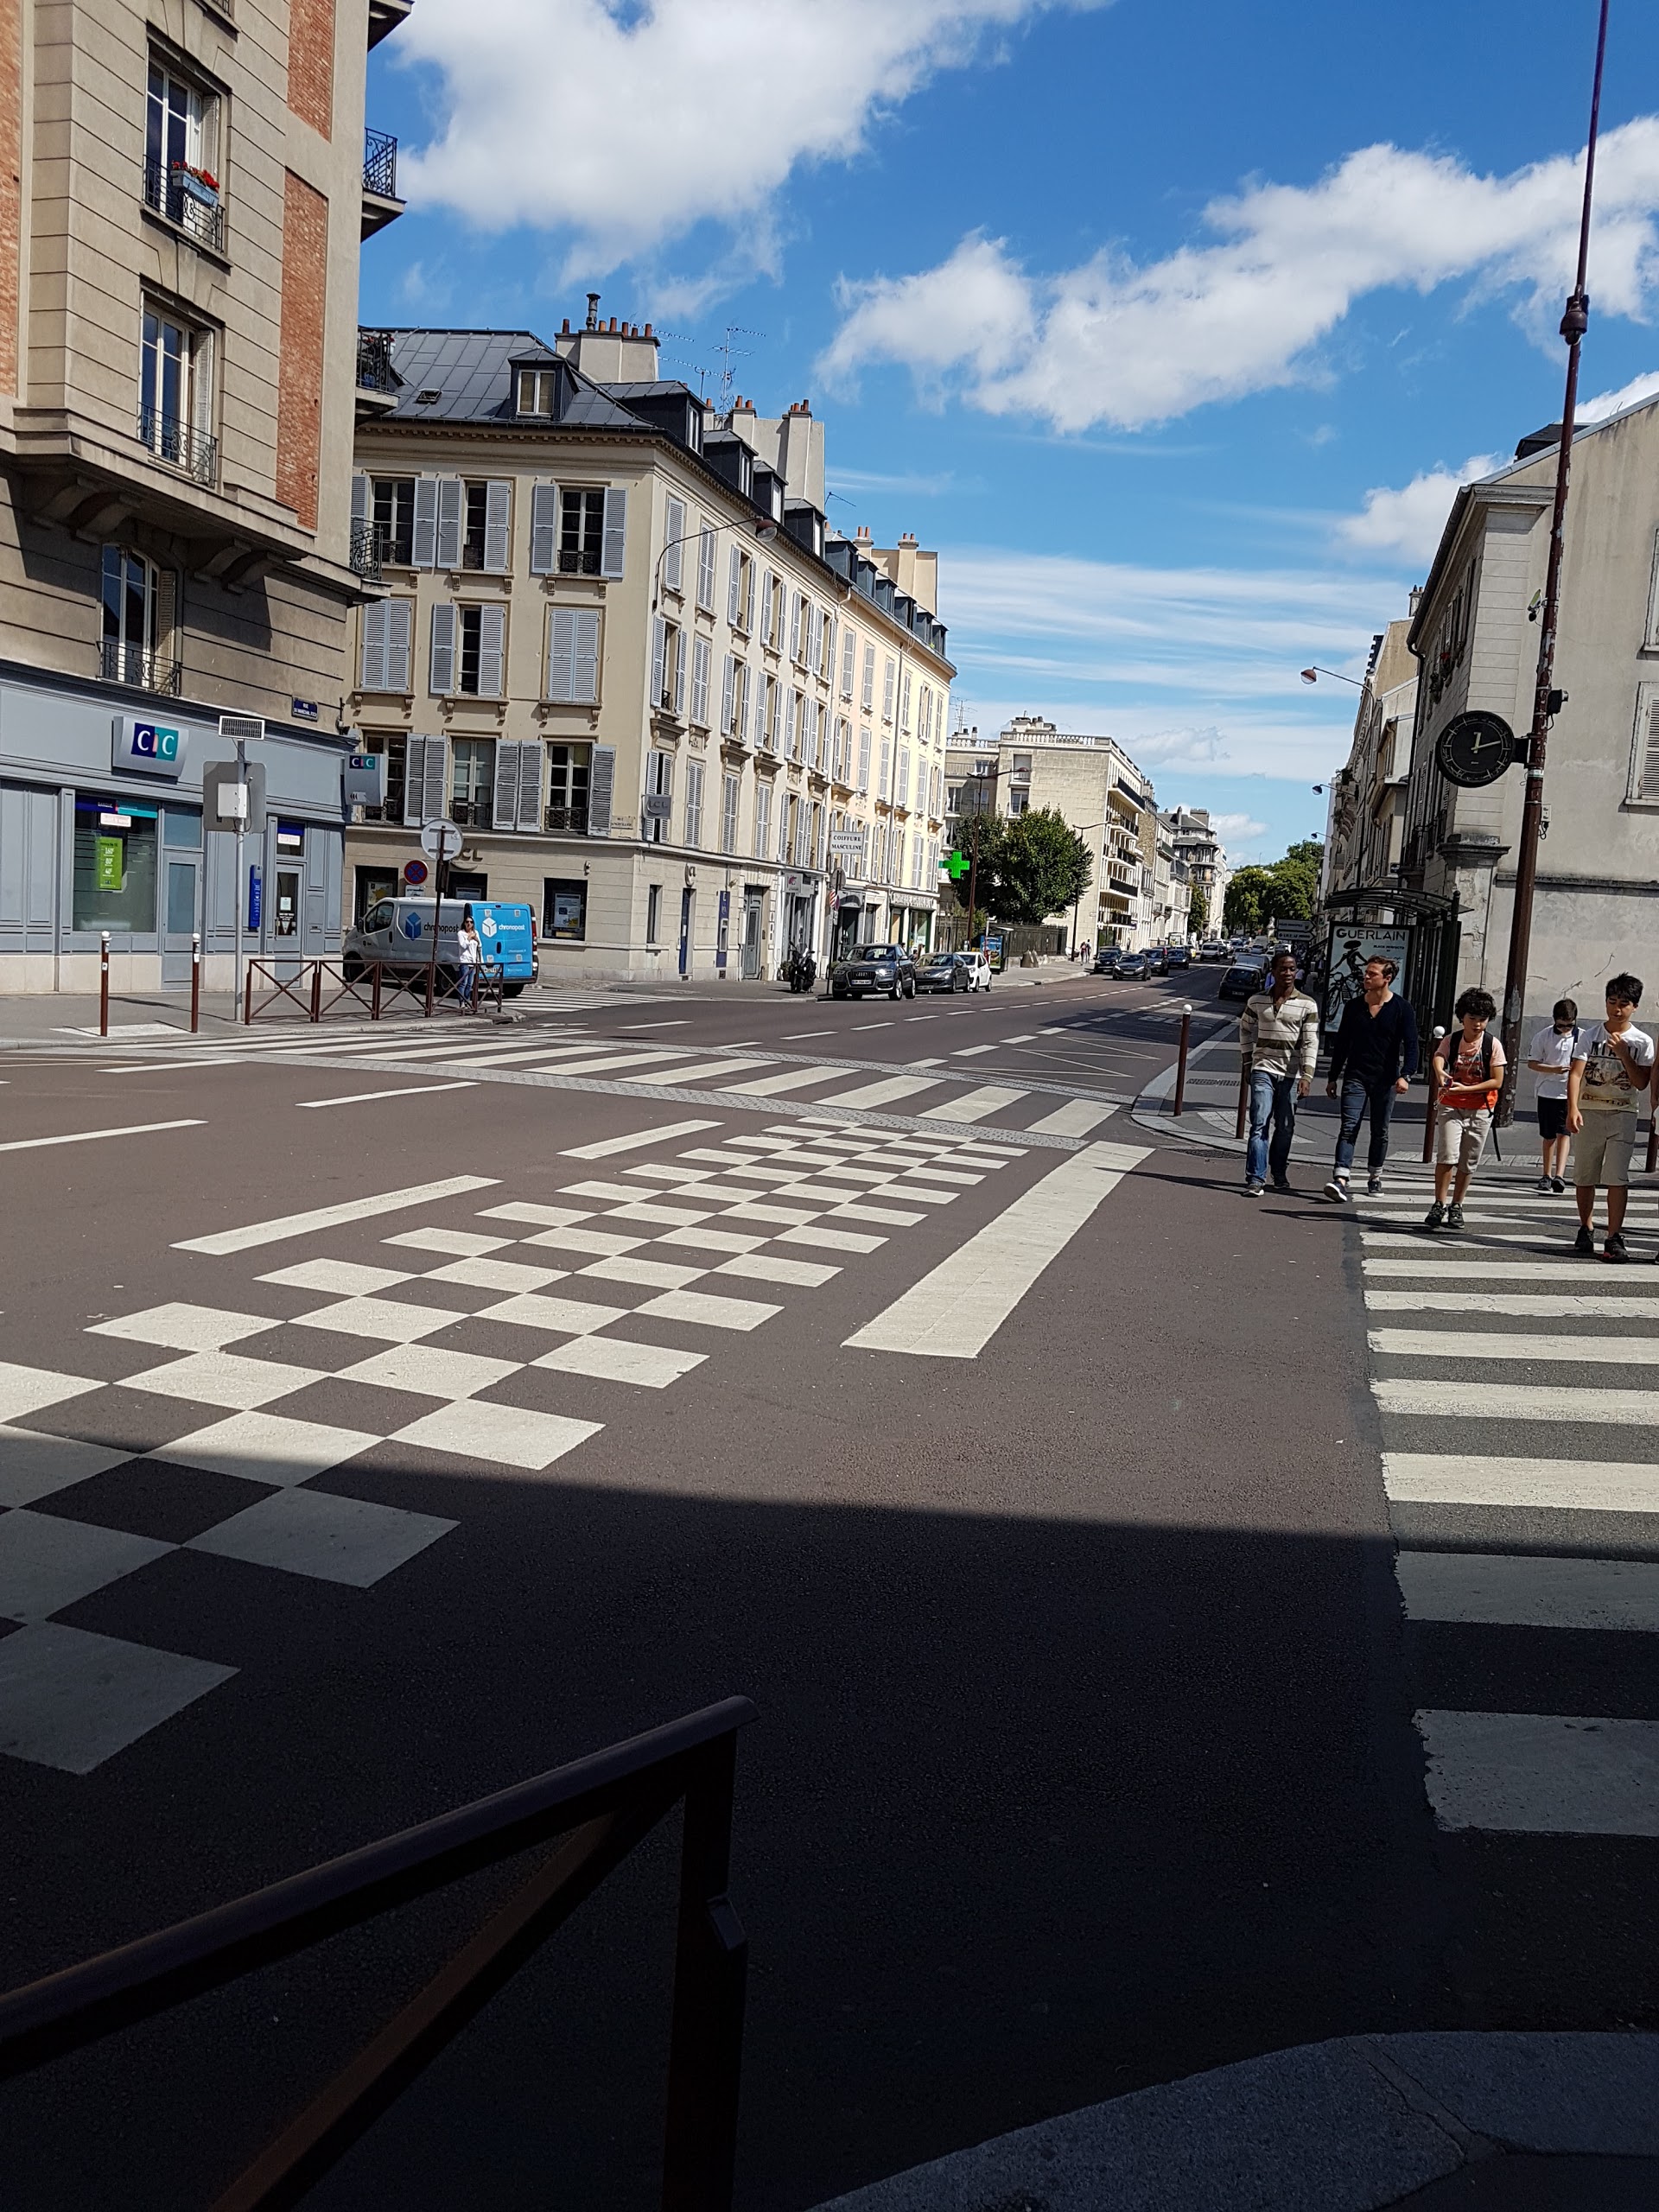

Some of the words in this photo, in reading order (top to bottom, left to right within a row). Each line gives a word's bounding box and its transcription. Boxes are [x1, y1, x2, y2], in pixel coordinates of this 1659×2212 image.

[137, 730, 175, 755] CIC
[351, 757, 374, 767] CIC
[649, 800, 669, 809] LCL
[458, 848, 483, 861] CL
[423, 922, 460, 934] chrnopost
[1336, 928, 1406, 942] GUERLAIN
